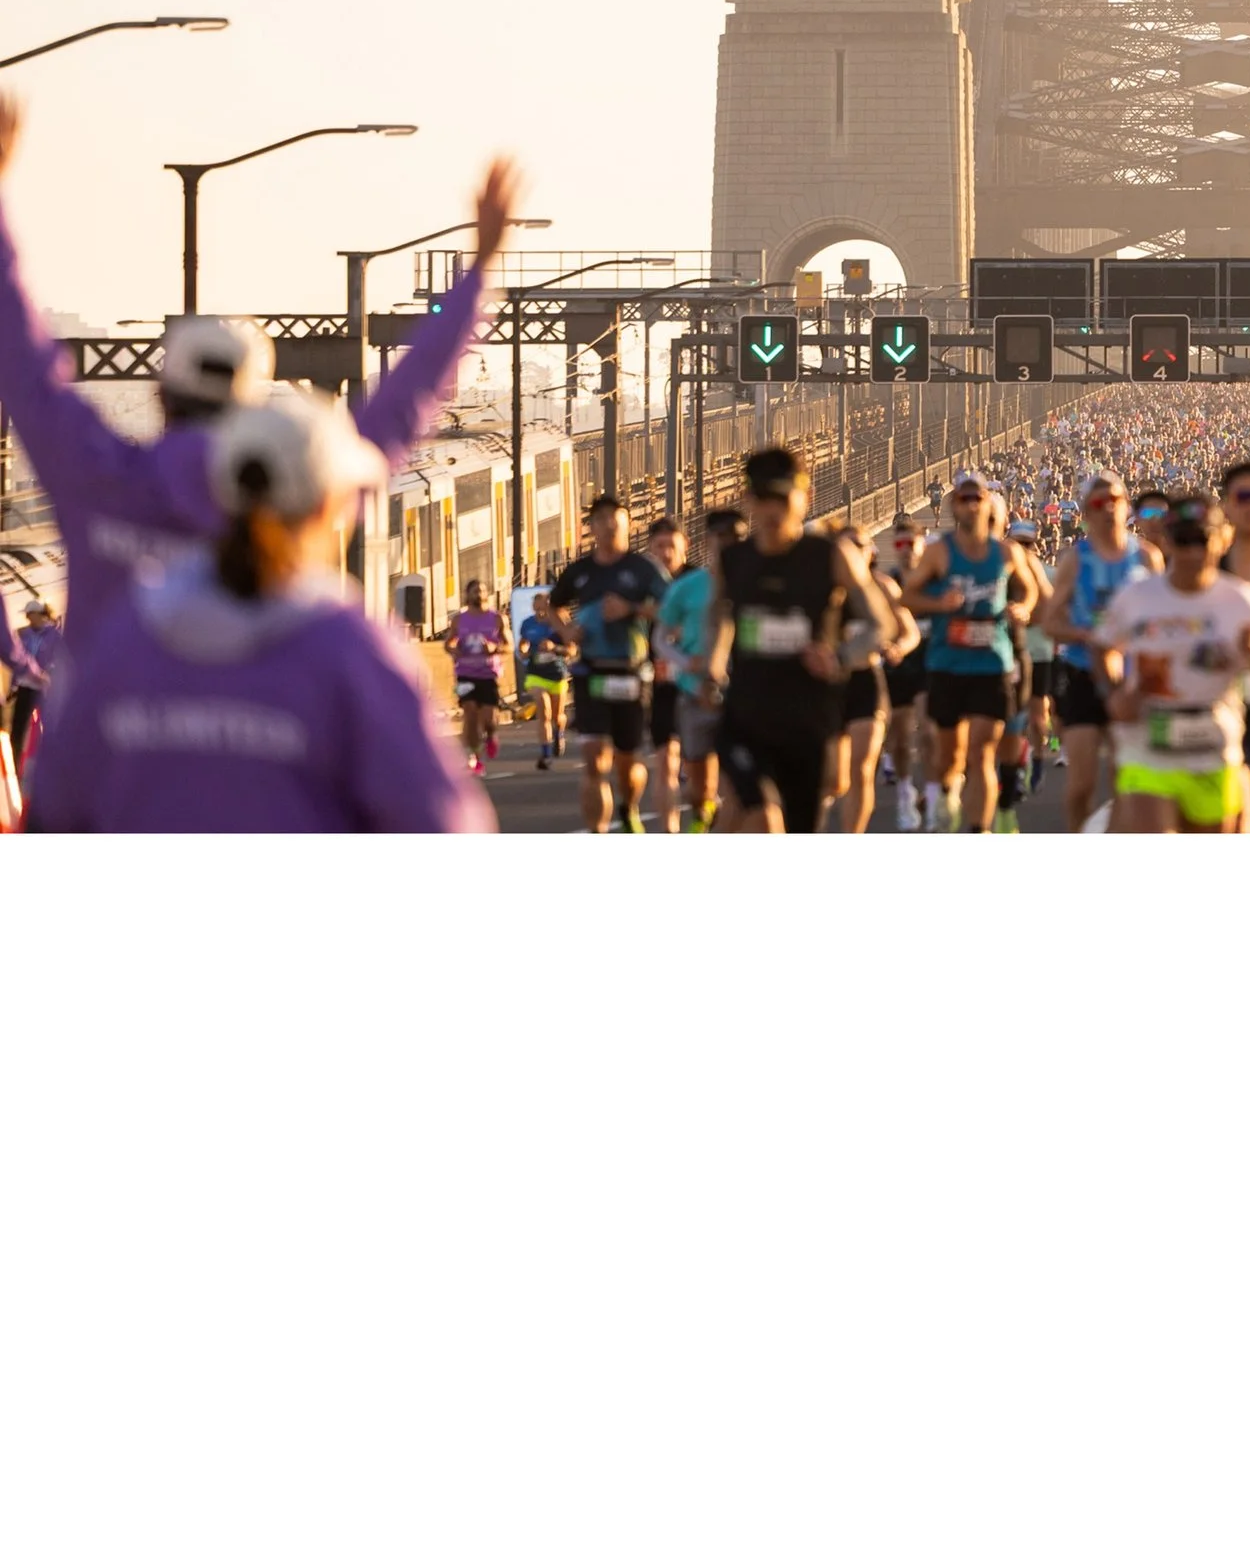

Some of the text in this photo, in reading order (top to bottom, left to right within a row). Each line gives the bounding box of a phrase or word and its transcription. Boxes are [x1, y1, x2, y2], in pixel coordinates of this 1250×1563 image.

[894, 366, 907, 381] 2
[1018, 366, 1030, 381] 3
[1153, 366, 1167, 381] 4
